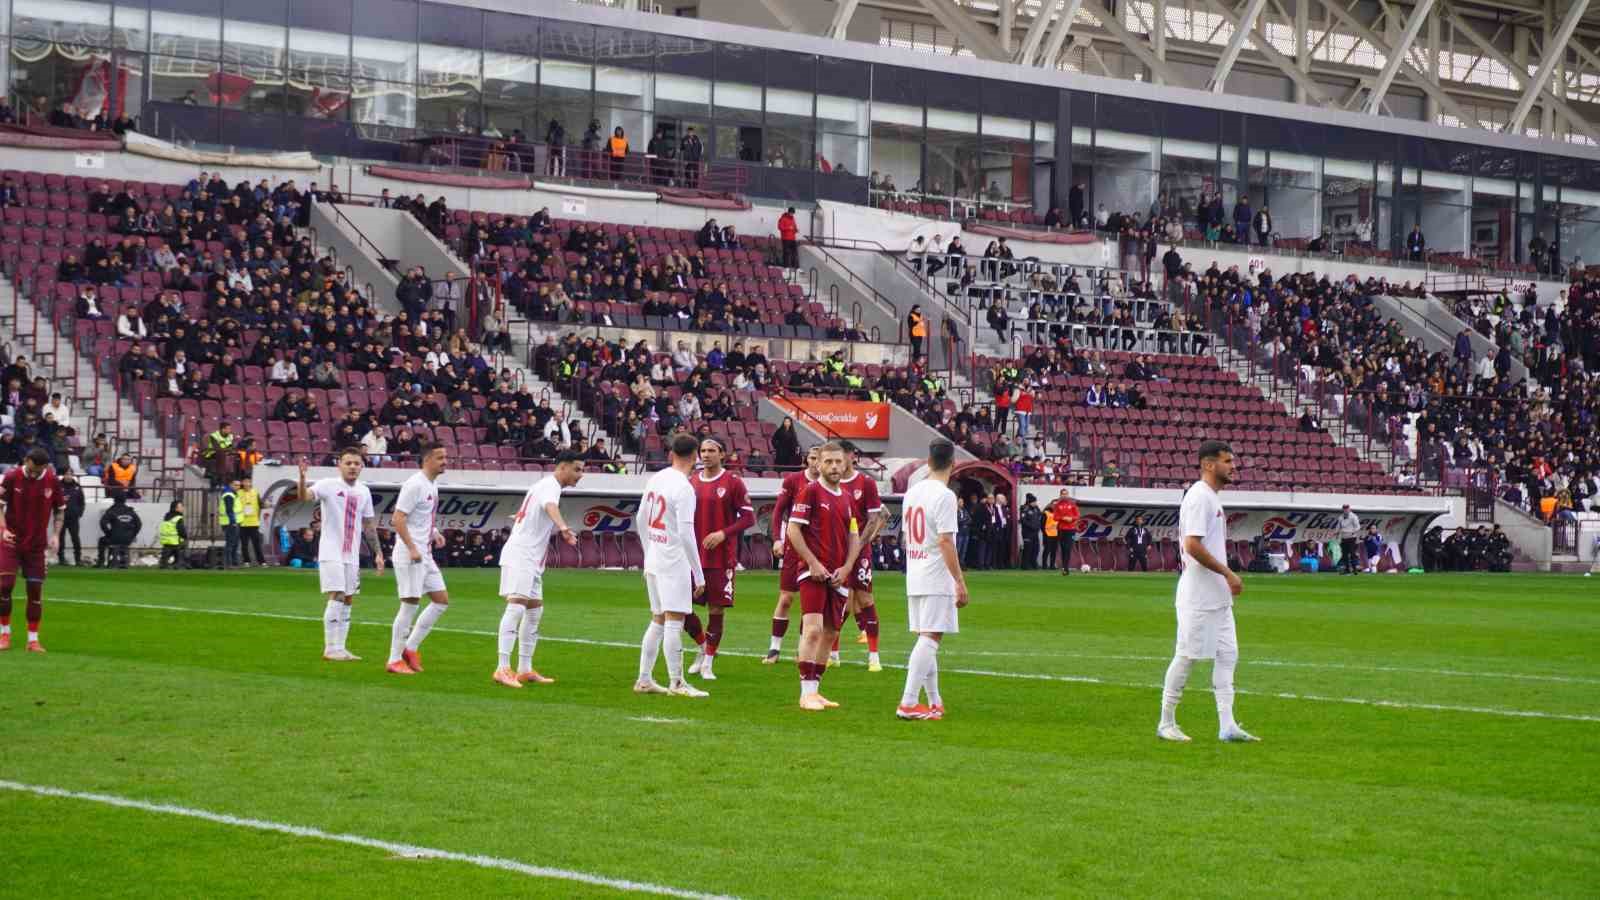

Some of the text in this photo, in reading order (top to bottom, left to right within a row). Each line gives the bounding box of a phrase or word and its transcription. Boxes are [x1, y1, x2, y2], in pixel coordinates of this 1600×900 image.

[1249, 259, 1264, 269] 401
[905, 506, 925, 545] 10
[723, 580, 734, 595] 4
